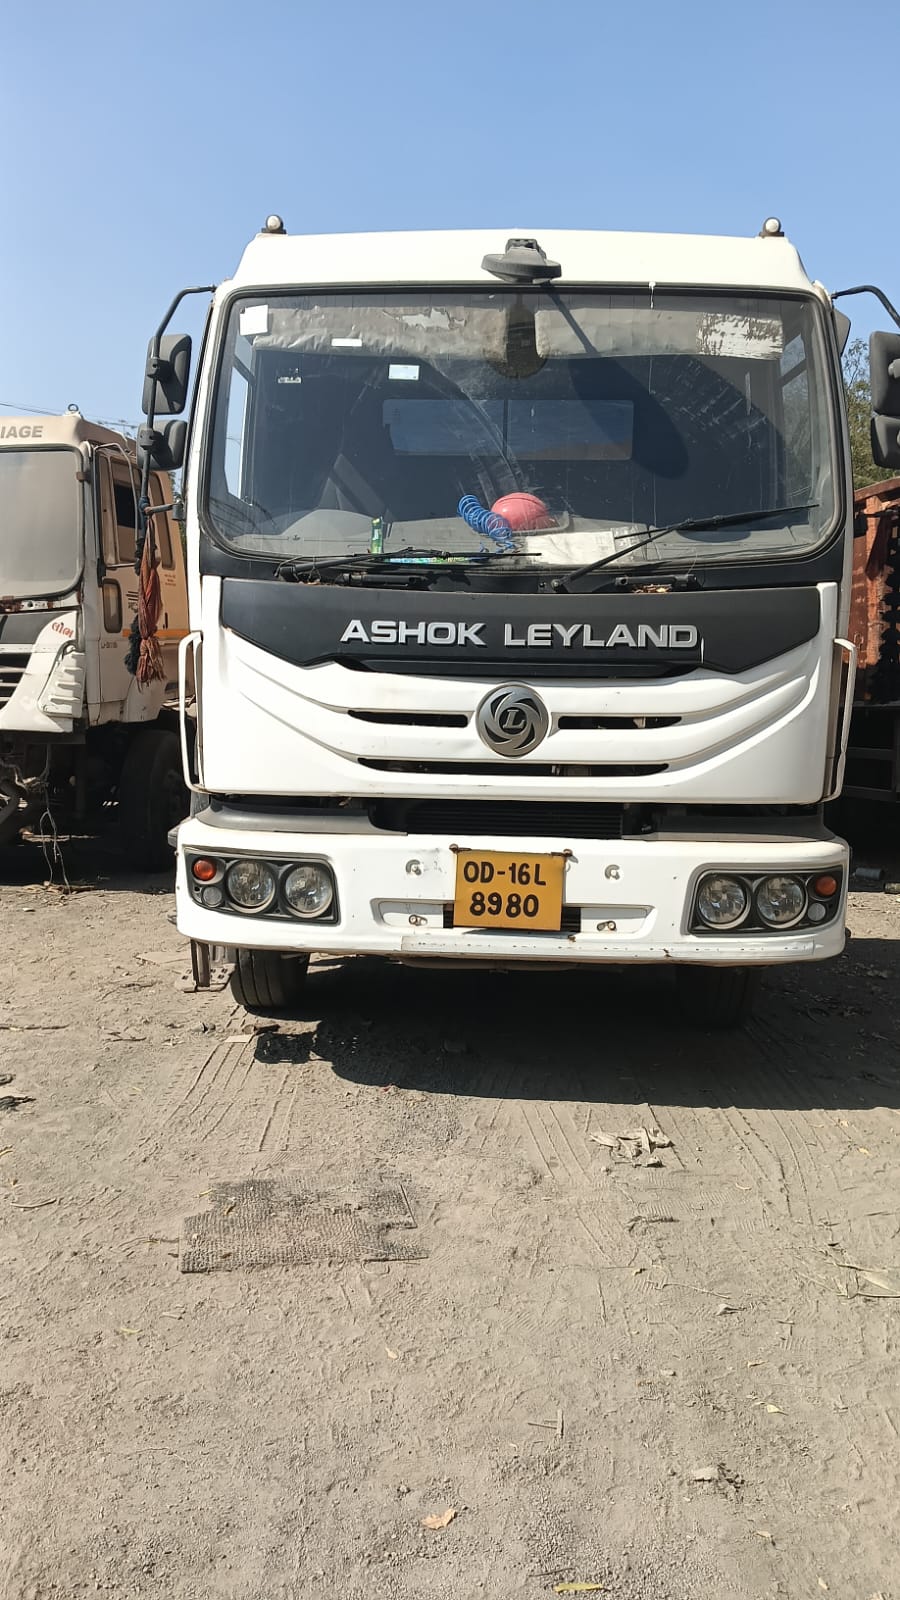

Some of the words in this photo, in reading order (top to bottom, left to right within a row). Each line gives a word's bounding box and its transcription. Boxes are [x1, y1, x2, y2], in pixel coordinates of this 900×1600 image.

[340, 619, 485, 646] ASHOK
[504, 623, 699, 648] LEYLAND
[502, 709, 525, 730] L
[463, 861, 546, 885] OD-16L
[469, 891, 539, 918] 8980
